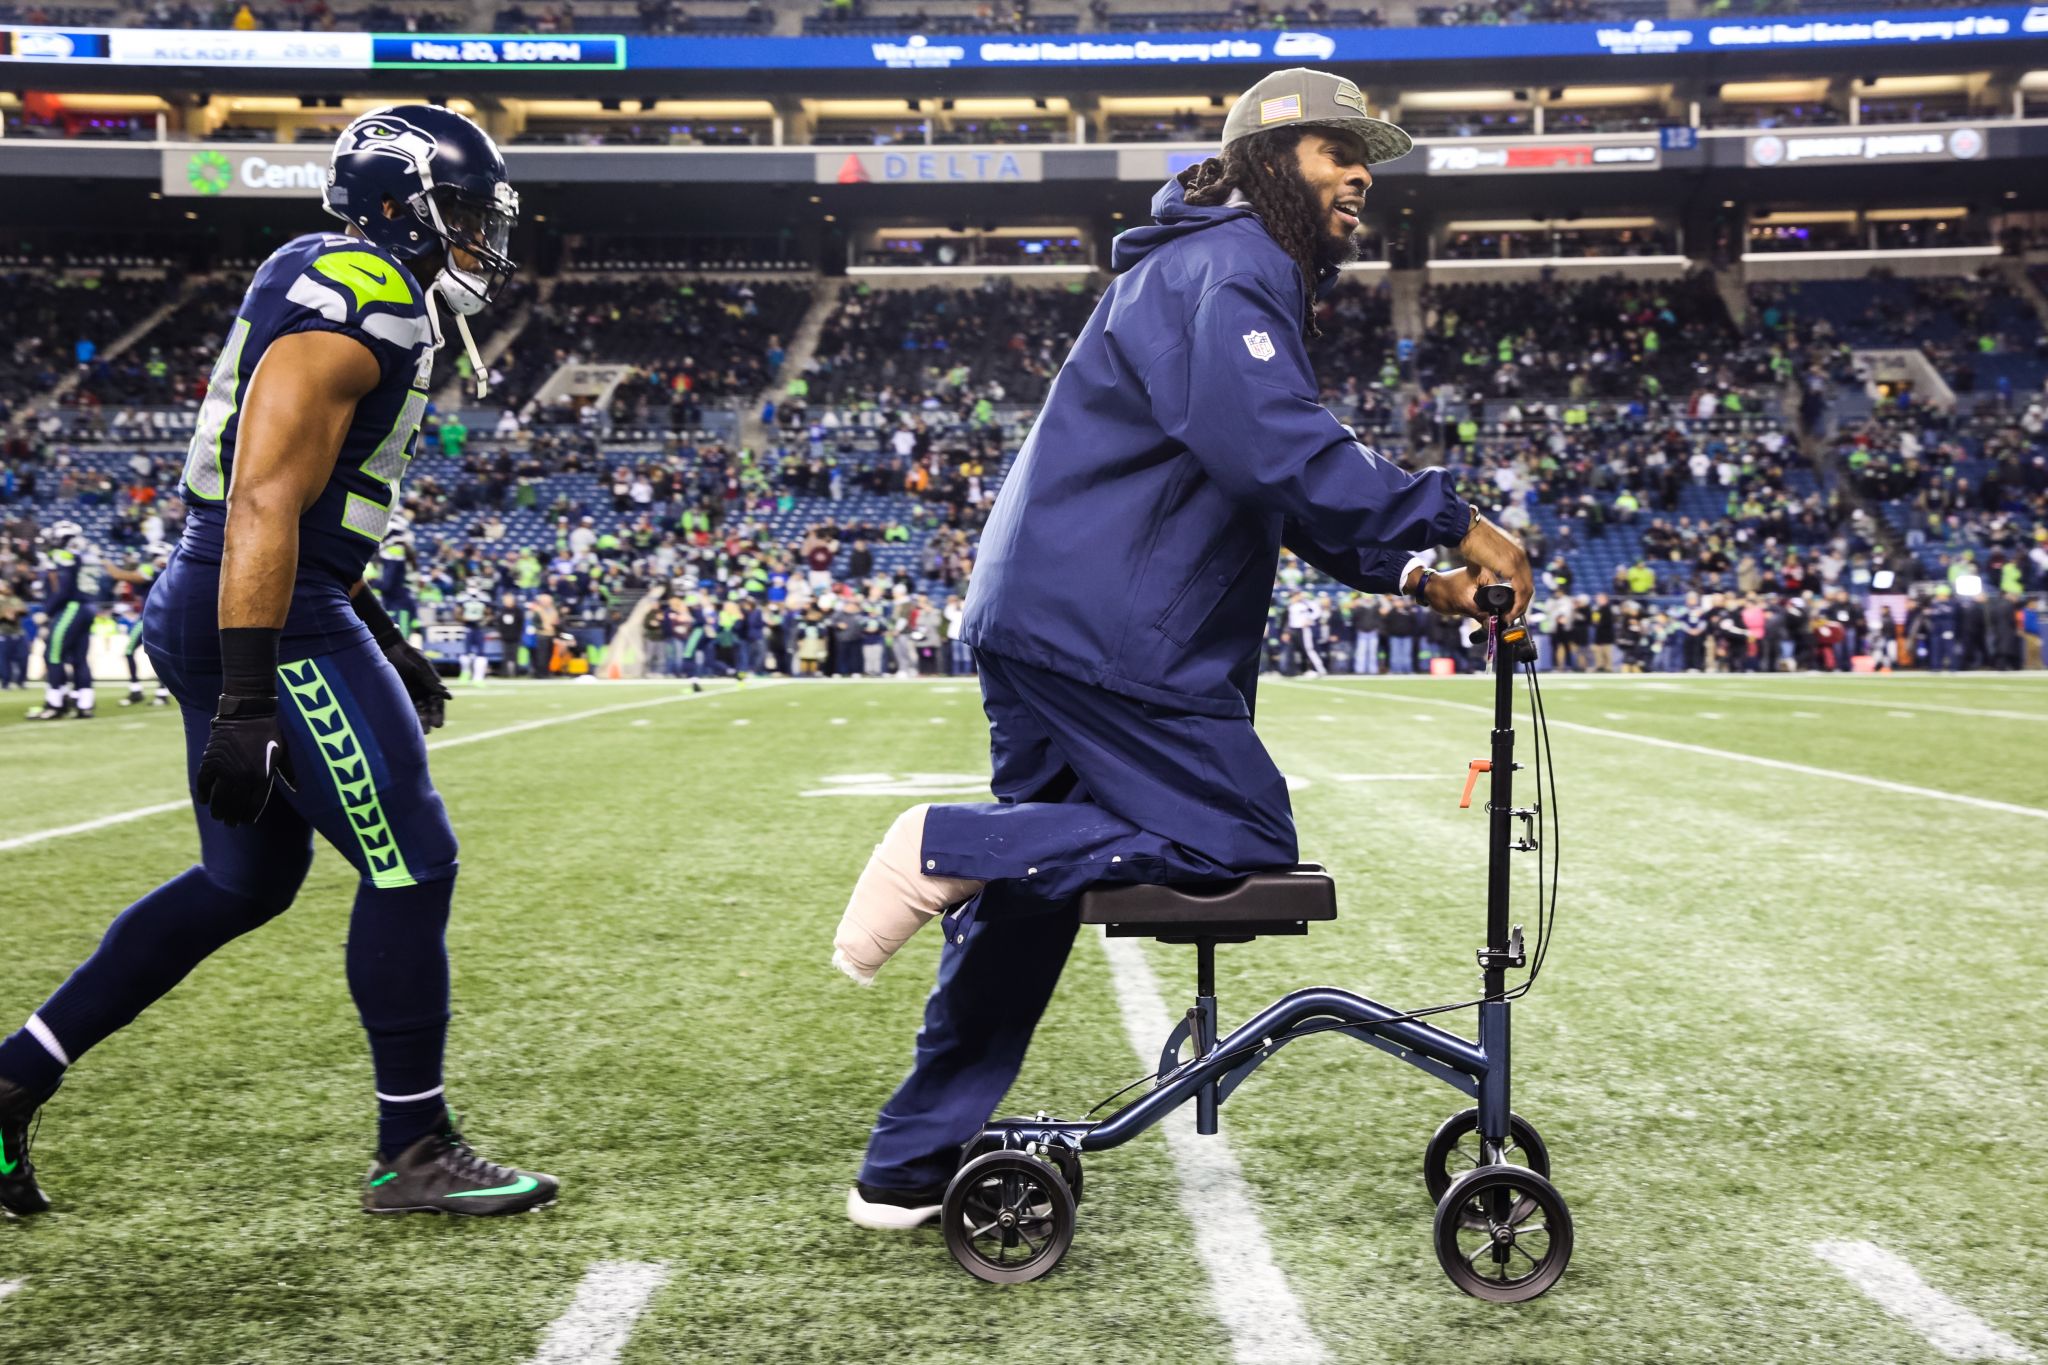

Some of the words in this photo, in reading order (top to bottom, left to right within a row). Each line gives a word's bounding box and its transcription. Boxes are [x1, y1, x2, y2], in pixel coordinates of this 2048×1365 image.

[1872, 20, 1954, 40] Company
[153, 46, 256, 61] KICKOFF
[1134, 41, 1210, 62] Company
[884, 153, 1021, 180] DELTA
